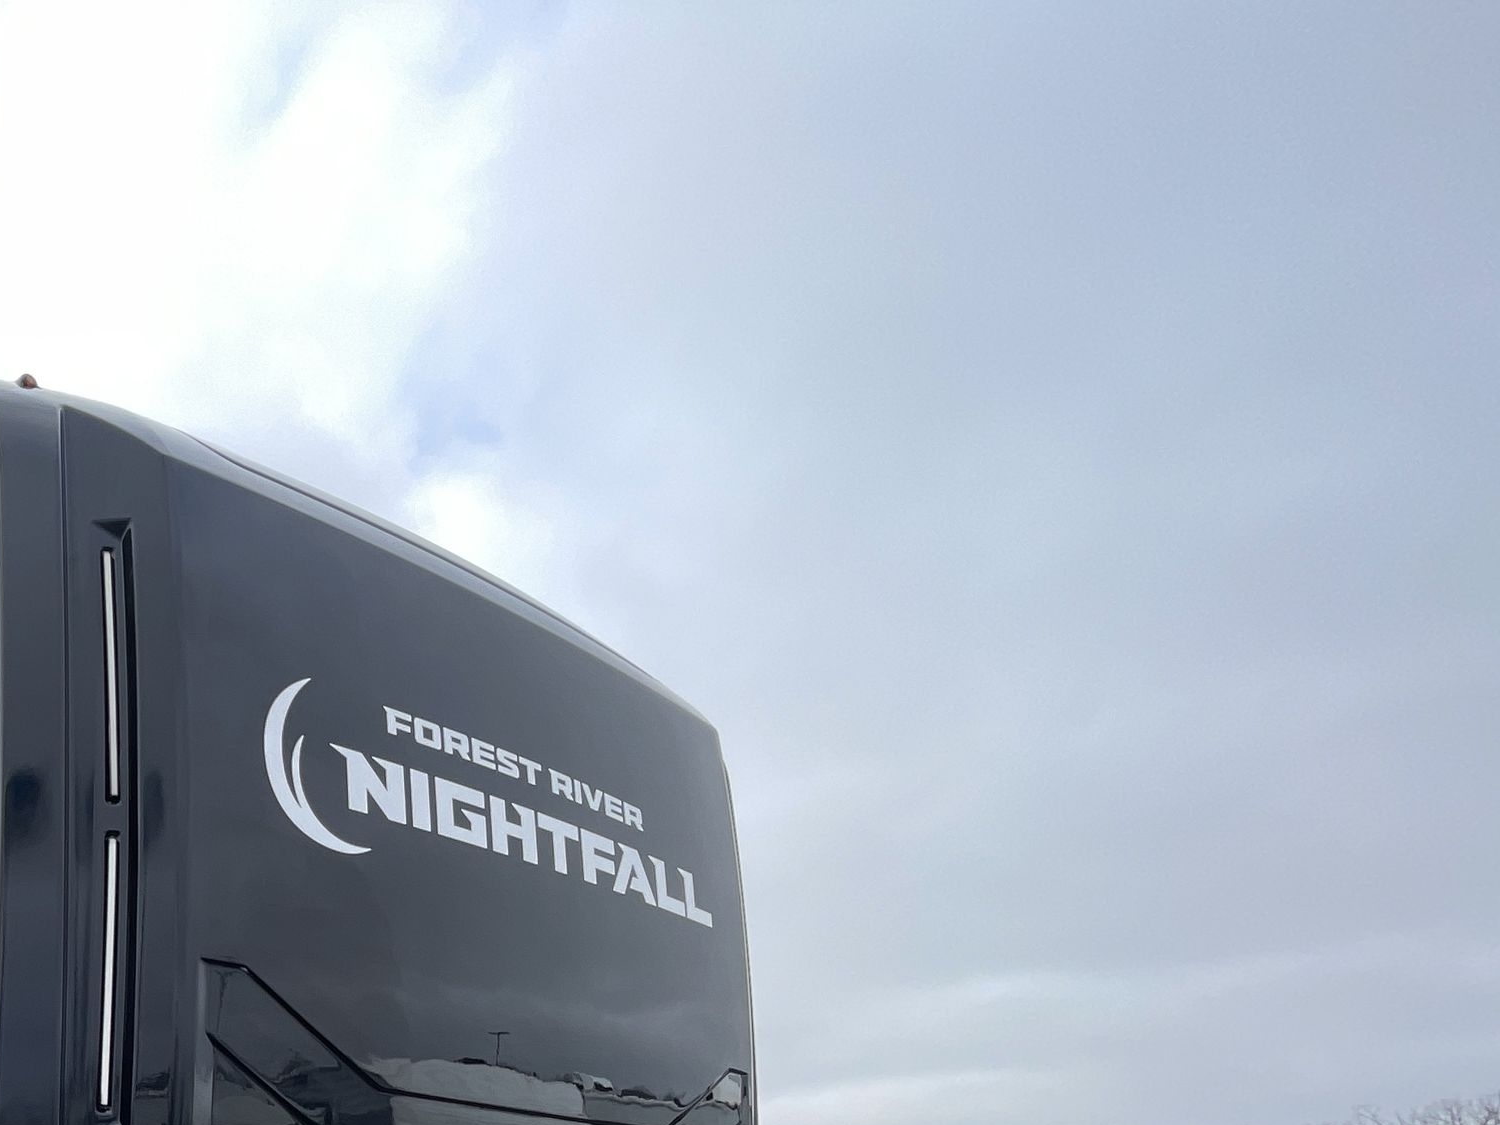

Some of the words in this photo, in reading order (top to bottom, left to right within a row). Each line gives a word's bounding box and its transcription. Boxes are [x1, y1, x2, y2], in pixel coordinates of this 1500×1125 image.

[328, 743, 714, 929] NIGHTFALL
[382, 704, 542, 786] FOREST
[547, 766, 644, 832] RIVER
